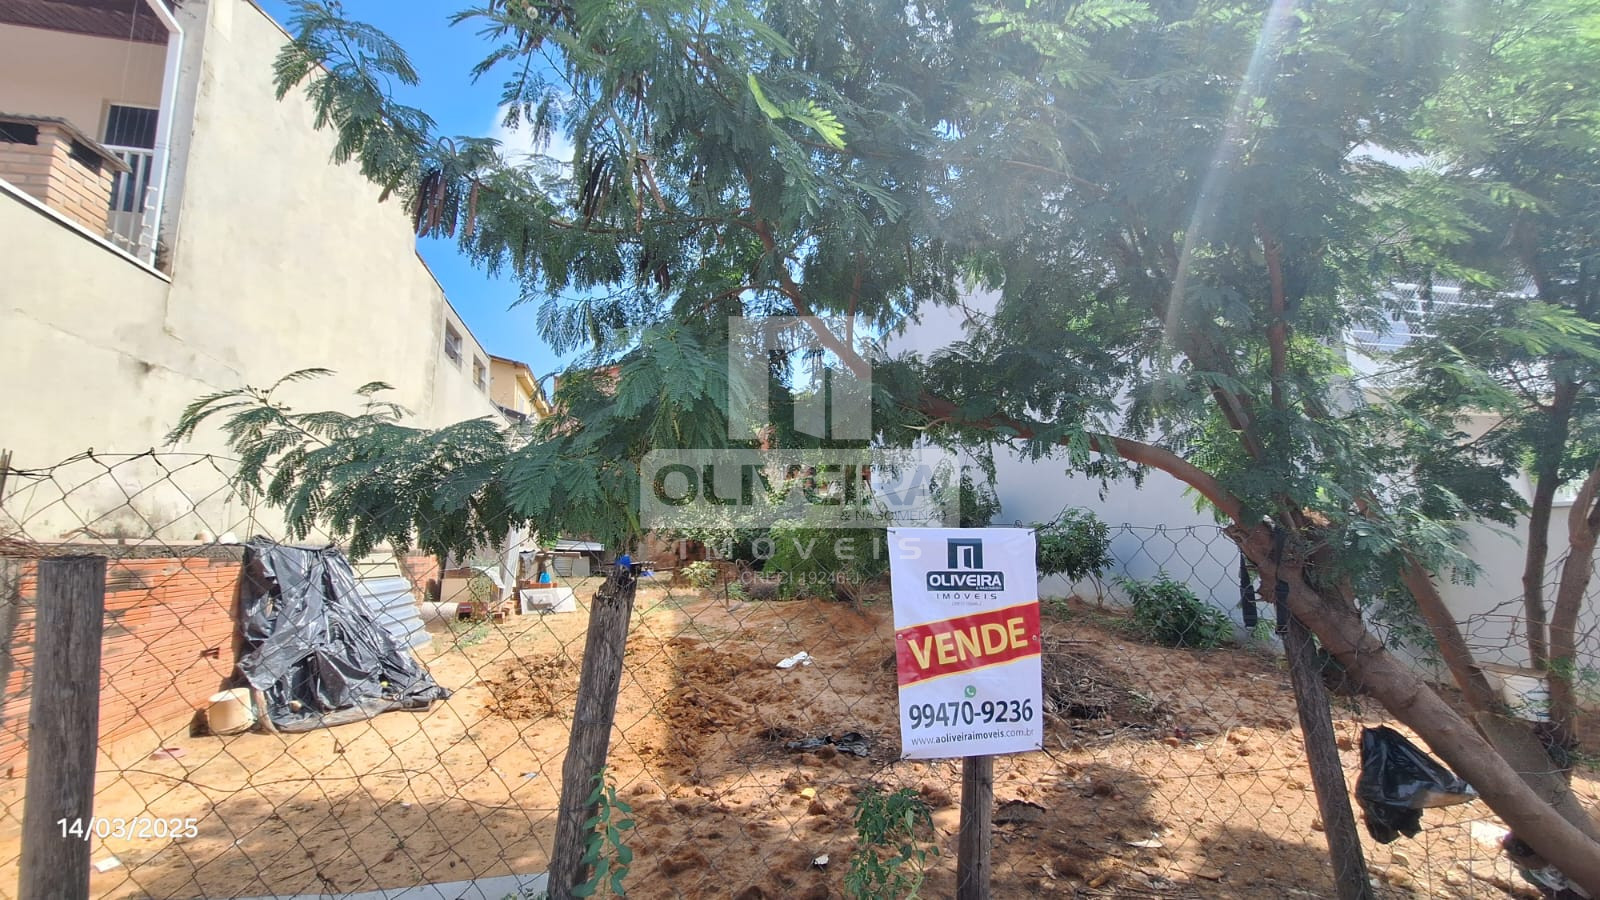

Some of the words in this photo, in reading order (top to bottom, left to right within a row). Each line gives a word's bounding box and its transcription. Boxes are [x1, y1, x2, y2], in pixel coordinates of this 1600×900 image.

[929, 574, 1002, 587] OLIVEIRA
[907, 617, 1028, 670] VENDE
[909, 698, 1034, 730] 99470-9236
[911, 728, 1034, 746] www.aoliveiraimoveis.com.br
